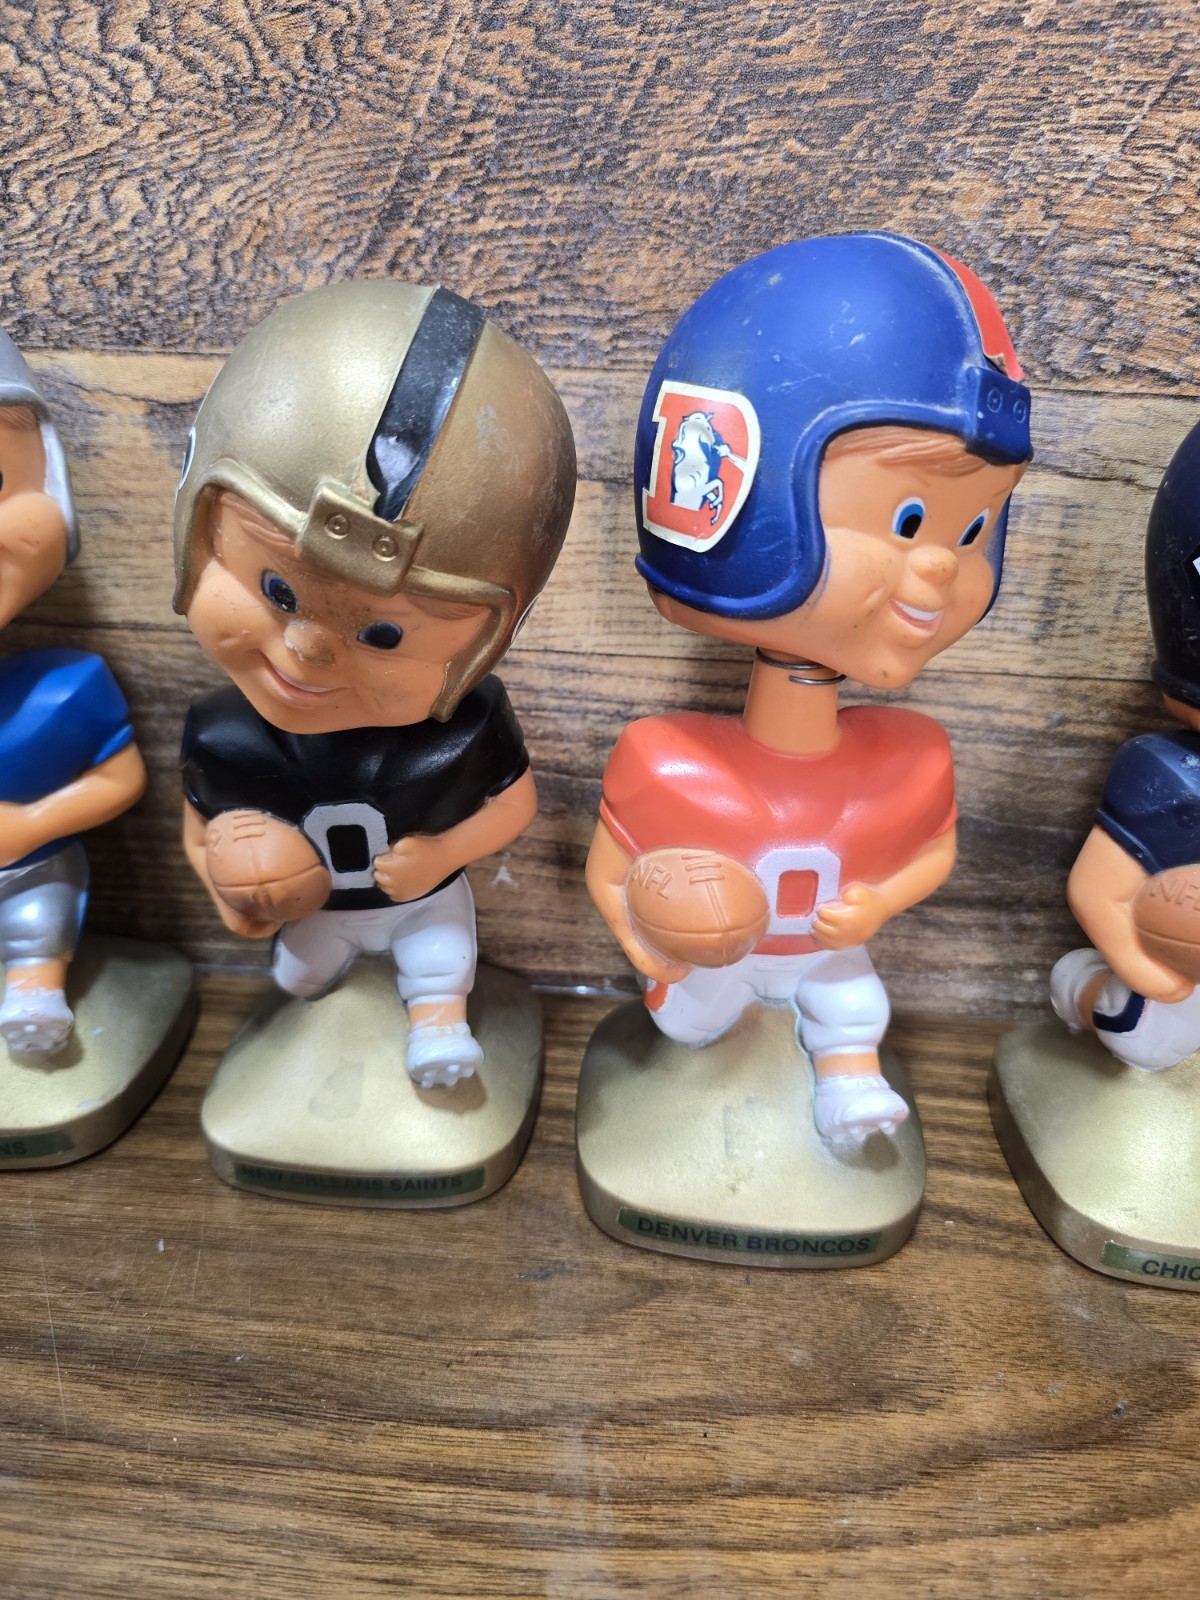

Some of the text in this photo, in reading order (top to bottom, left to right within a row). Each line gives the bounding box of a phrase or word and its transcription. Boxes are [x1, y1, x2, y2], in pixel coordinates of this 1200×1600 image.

[630, 862, 673, 901] NFL
[390, 1174, 463, 1192] SAINTS
[637, 1216, 871, 1255] DENVER BRONCOS
